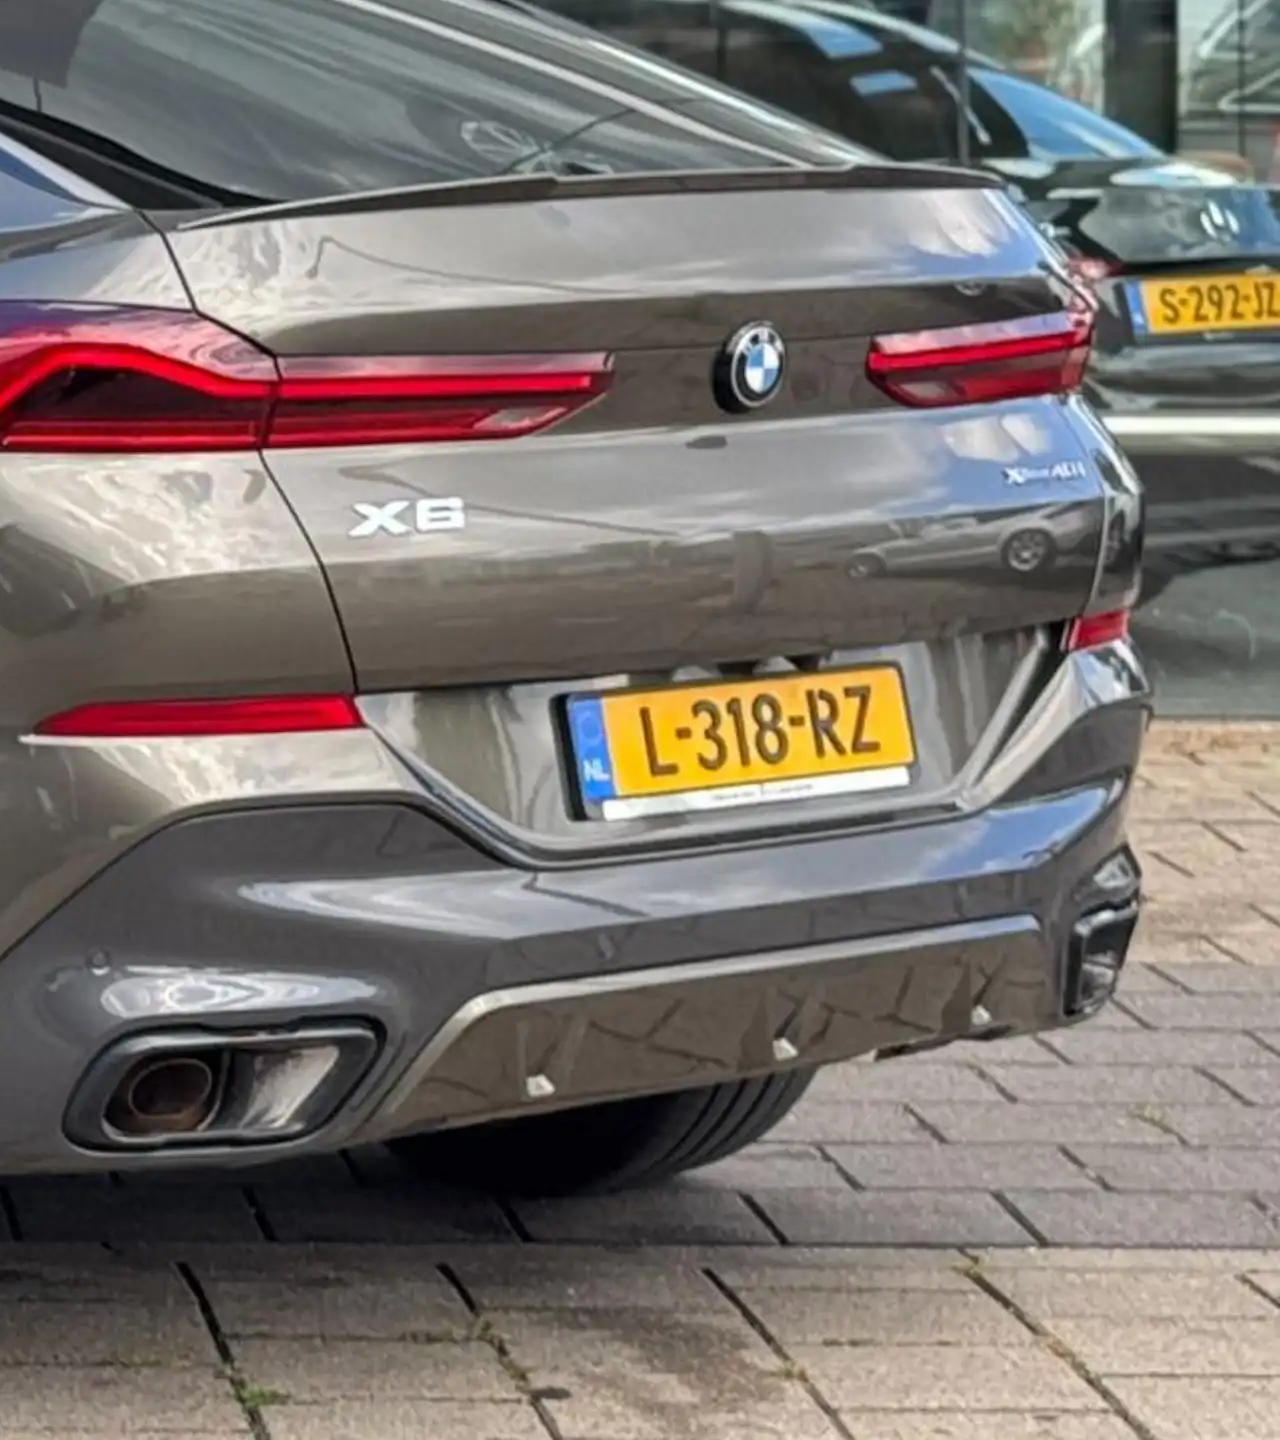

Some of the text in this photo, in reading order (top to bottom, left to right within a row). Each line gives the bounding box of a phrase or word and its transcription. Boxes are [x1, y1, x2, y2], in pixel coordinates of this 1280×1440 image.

[1159, 280, 1280, 326] S-292-JZ
[347, 496, 466, 538] X6
[639, 685, 881, 777] L-318-RZ
